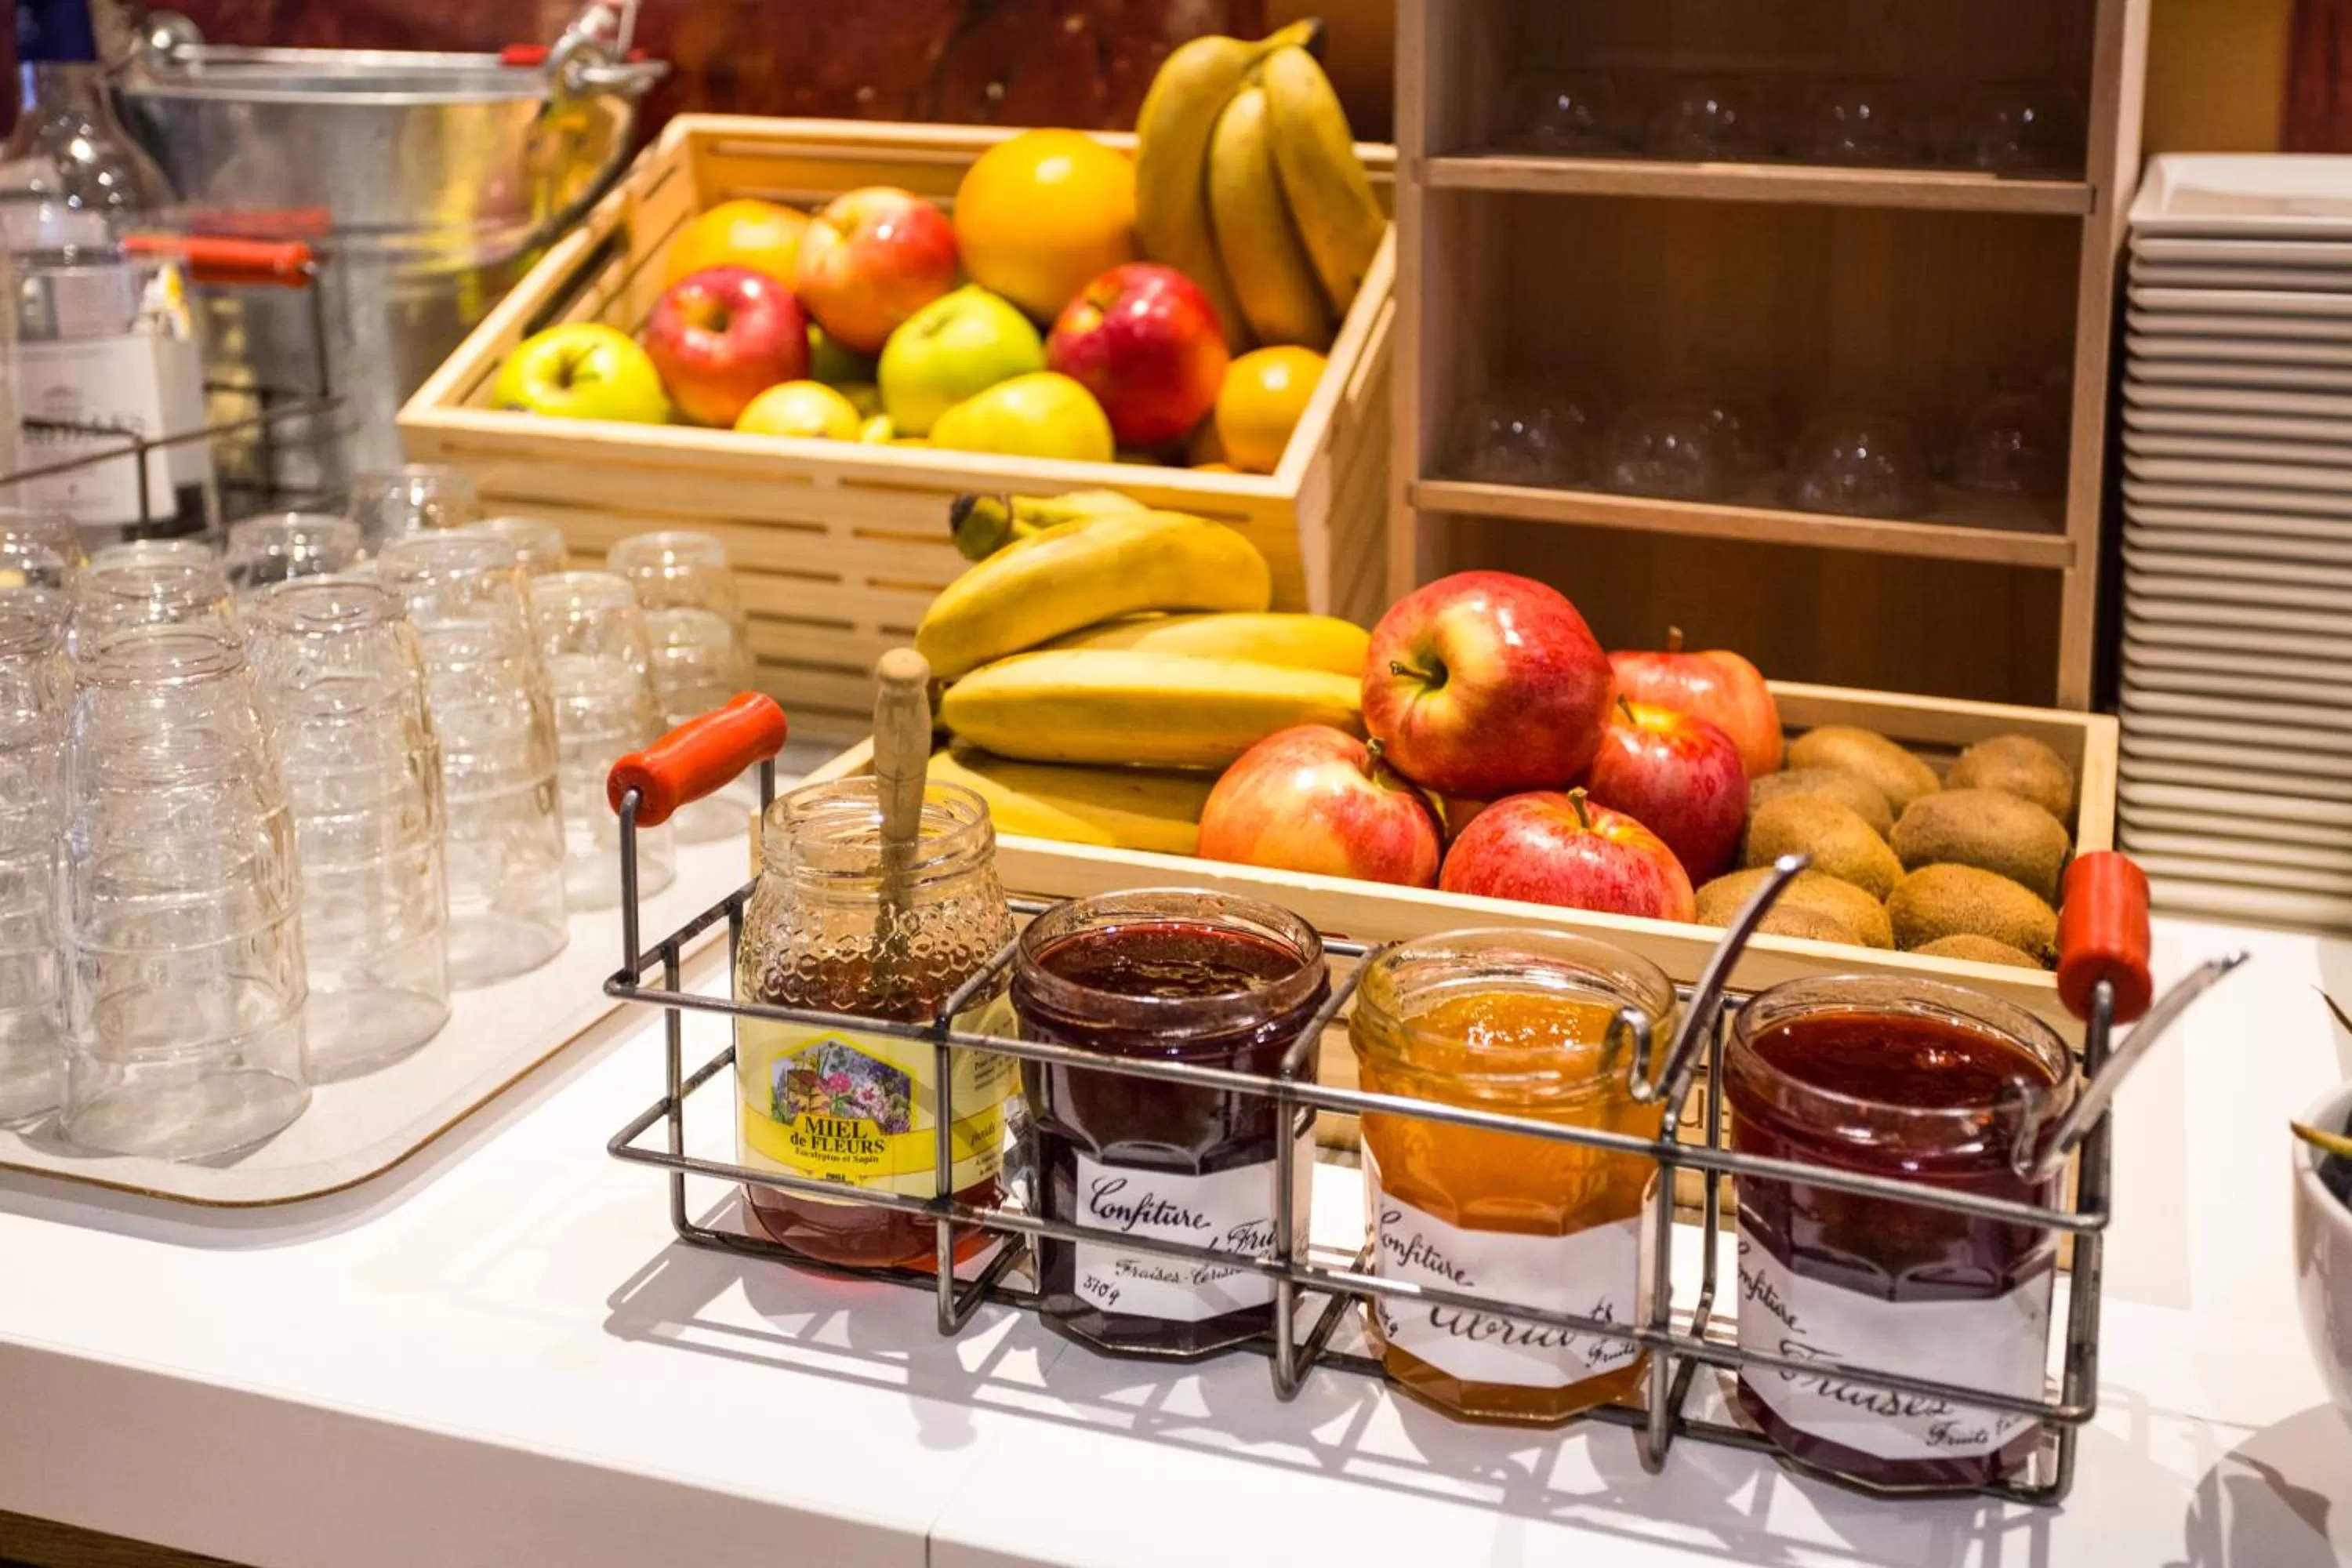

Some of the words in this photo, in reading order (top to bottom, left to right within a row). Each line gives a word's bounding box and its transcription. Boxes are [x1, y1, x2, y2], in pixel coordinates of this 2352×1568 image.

[804, 1116, 868, 1139] MIEL
[790, 1131, 807, 1147] de
[811, 1136, 885, 1155] FLEURS
[1089, 1175, 1211, 1232] Confiture
